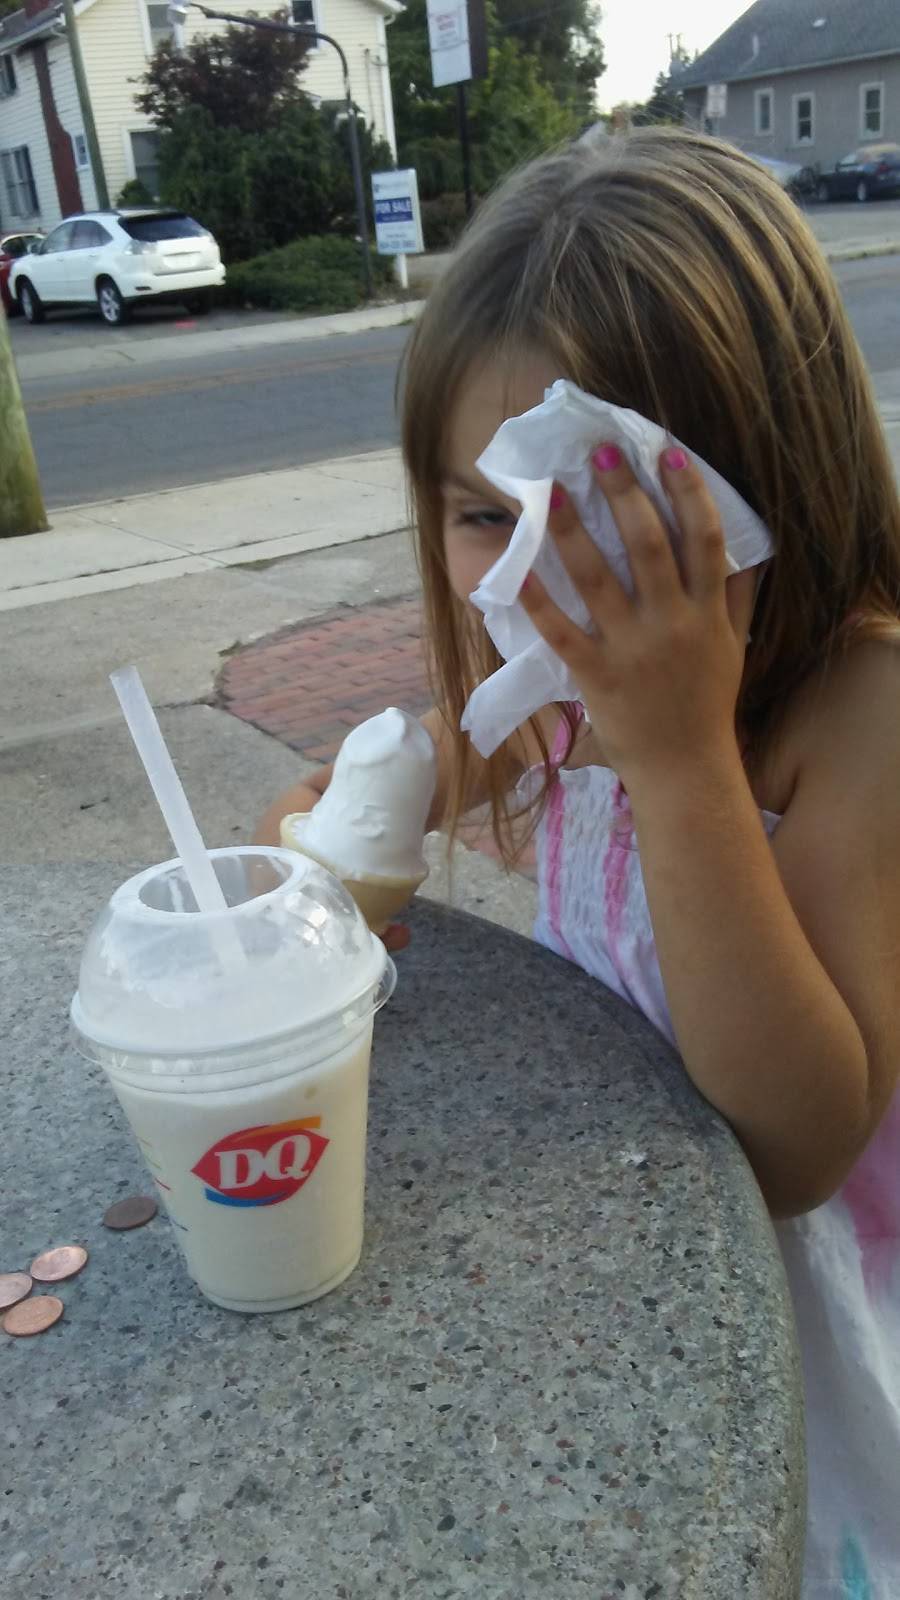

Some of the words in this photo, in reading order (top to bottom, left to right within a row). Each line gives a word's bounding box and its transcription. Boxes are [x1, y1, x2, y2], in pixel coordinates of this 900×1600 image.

[375, 202, 390, 213] FOR
[391, 199, 411, 212] SALE
[215, 1134, 311, 1190] DQ
